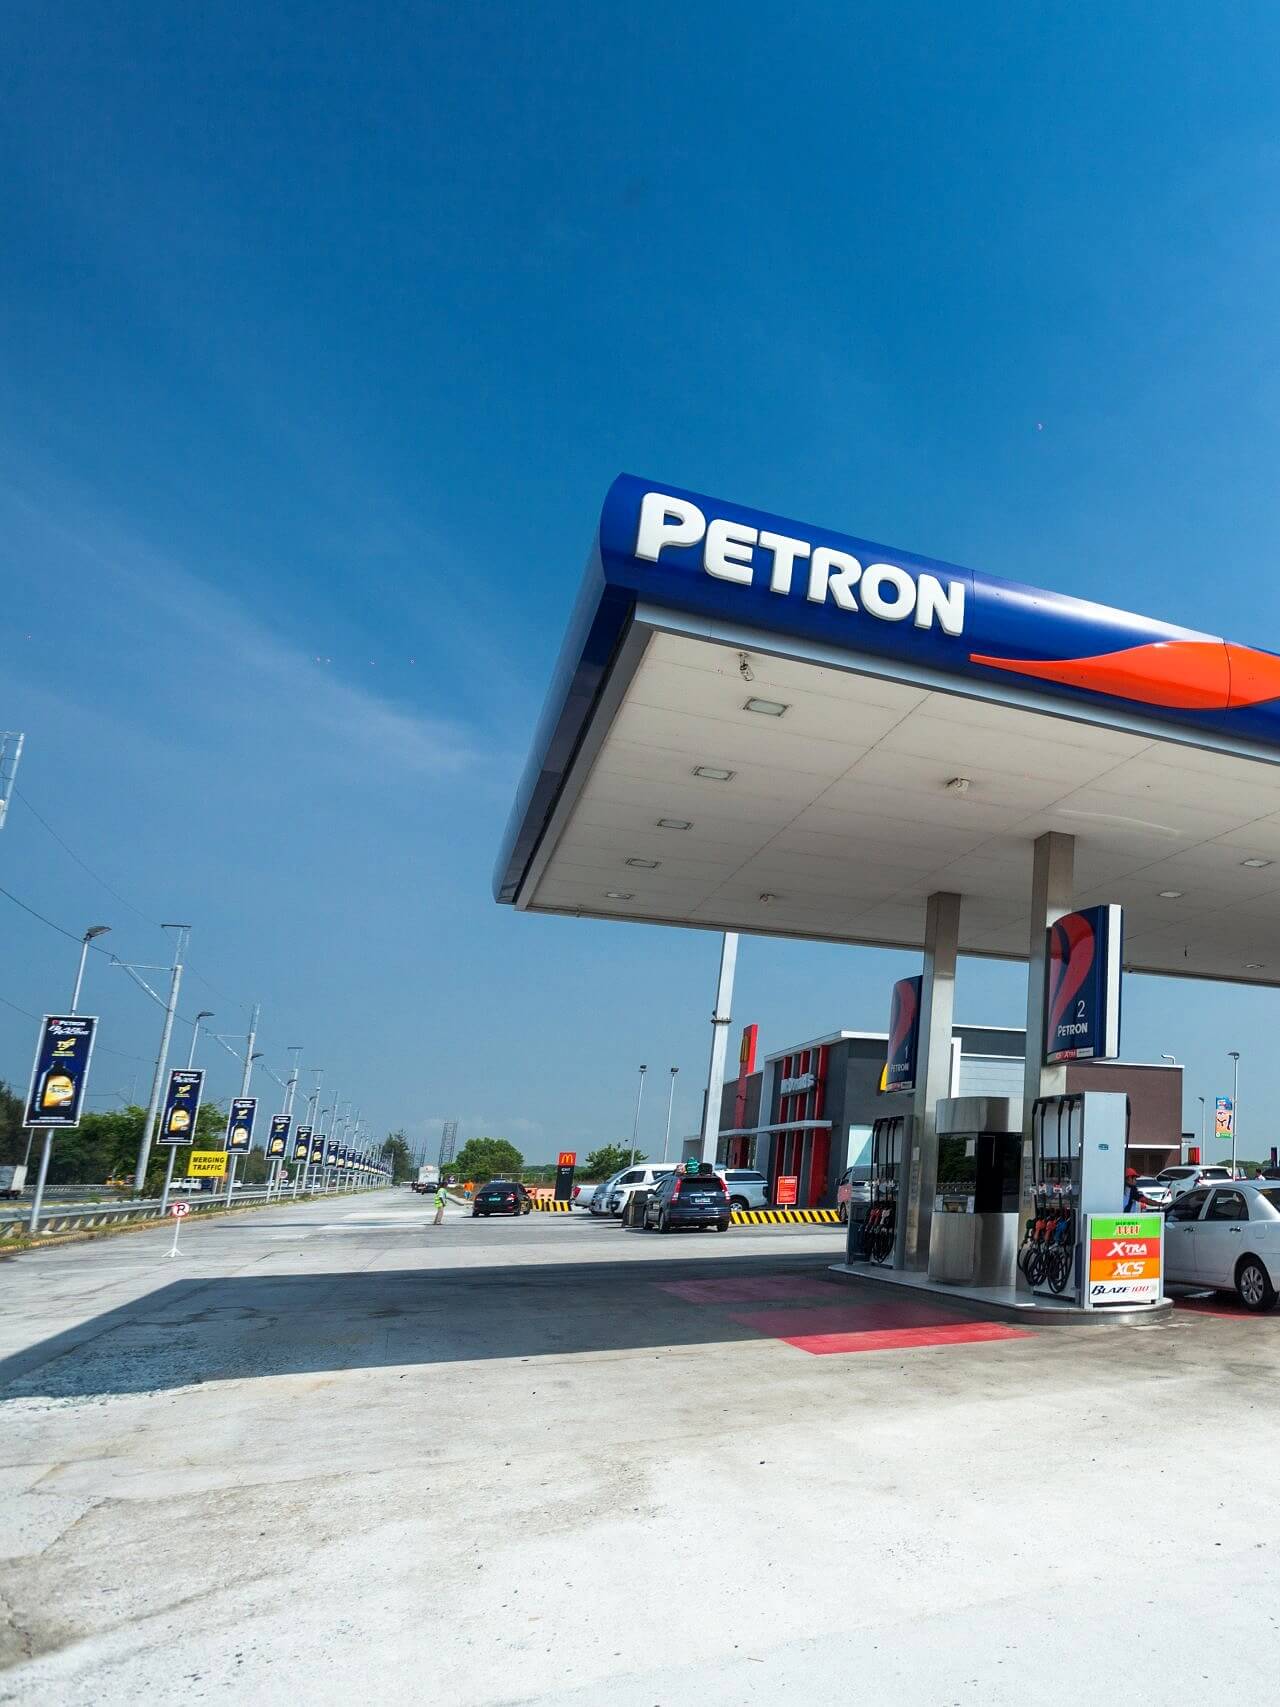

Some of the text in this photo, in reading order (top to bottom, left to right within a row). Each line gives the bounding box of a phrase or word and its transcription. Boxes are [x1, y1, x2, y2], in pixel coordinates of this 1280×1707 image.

[635, 491, 966, 637] PETRON
[1077, 1000, 1086, 1018] 2
[1057, 1022, 1089, 1038] PETRON
[890, 1063, 910, 1073] PETRON
[1106, 1241, 1148, 1256] XTRA
[1112, 1262, 1146, 1276] XCS
[1091, 1285, 1130, 1295] BLAZE
